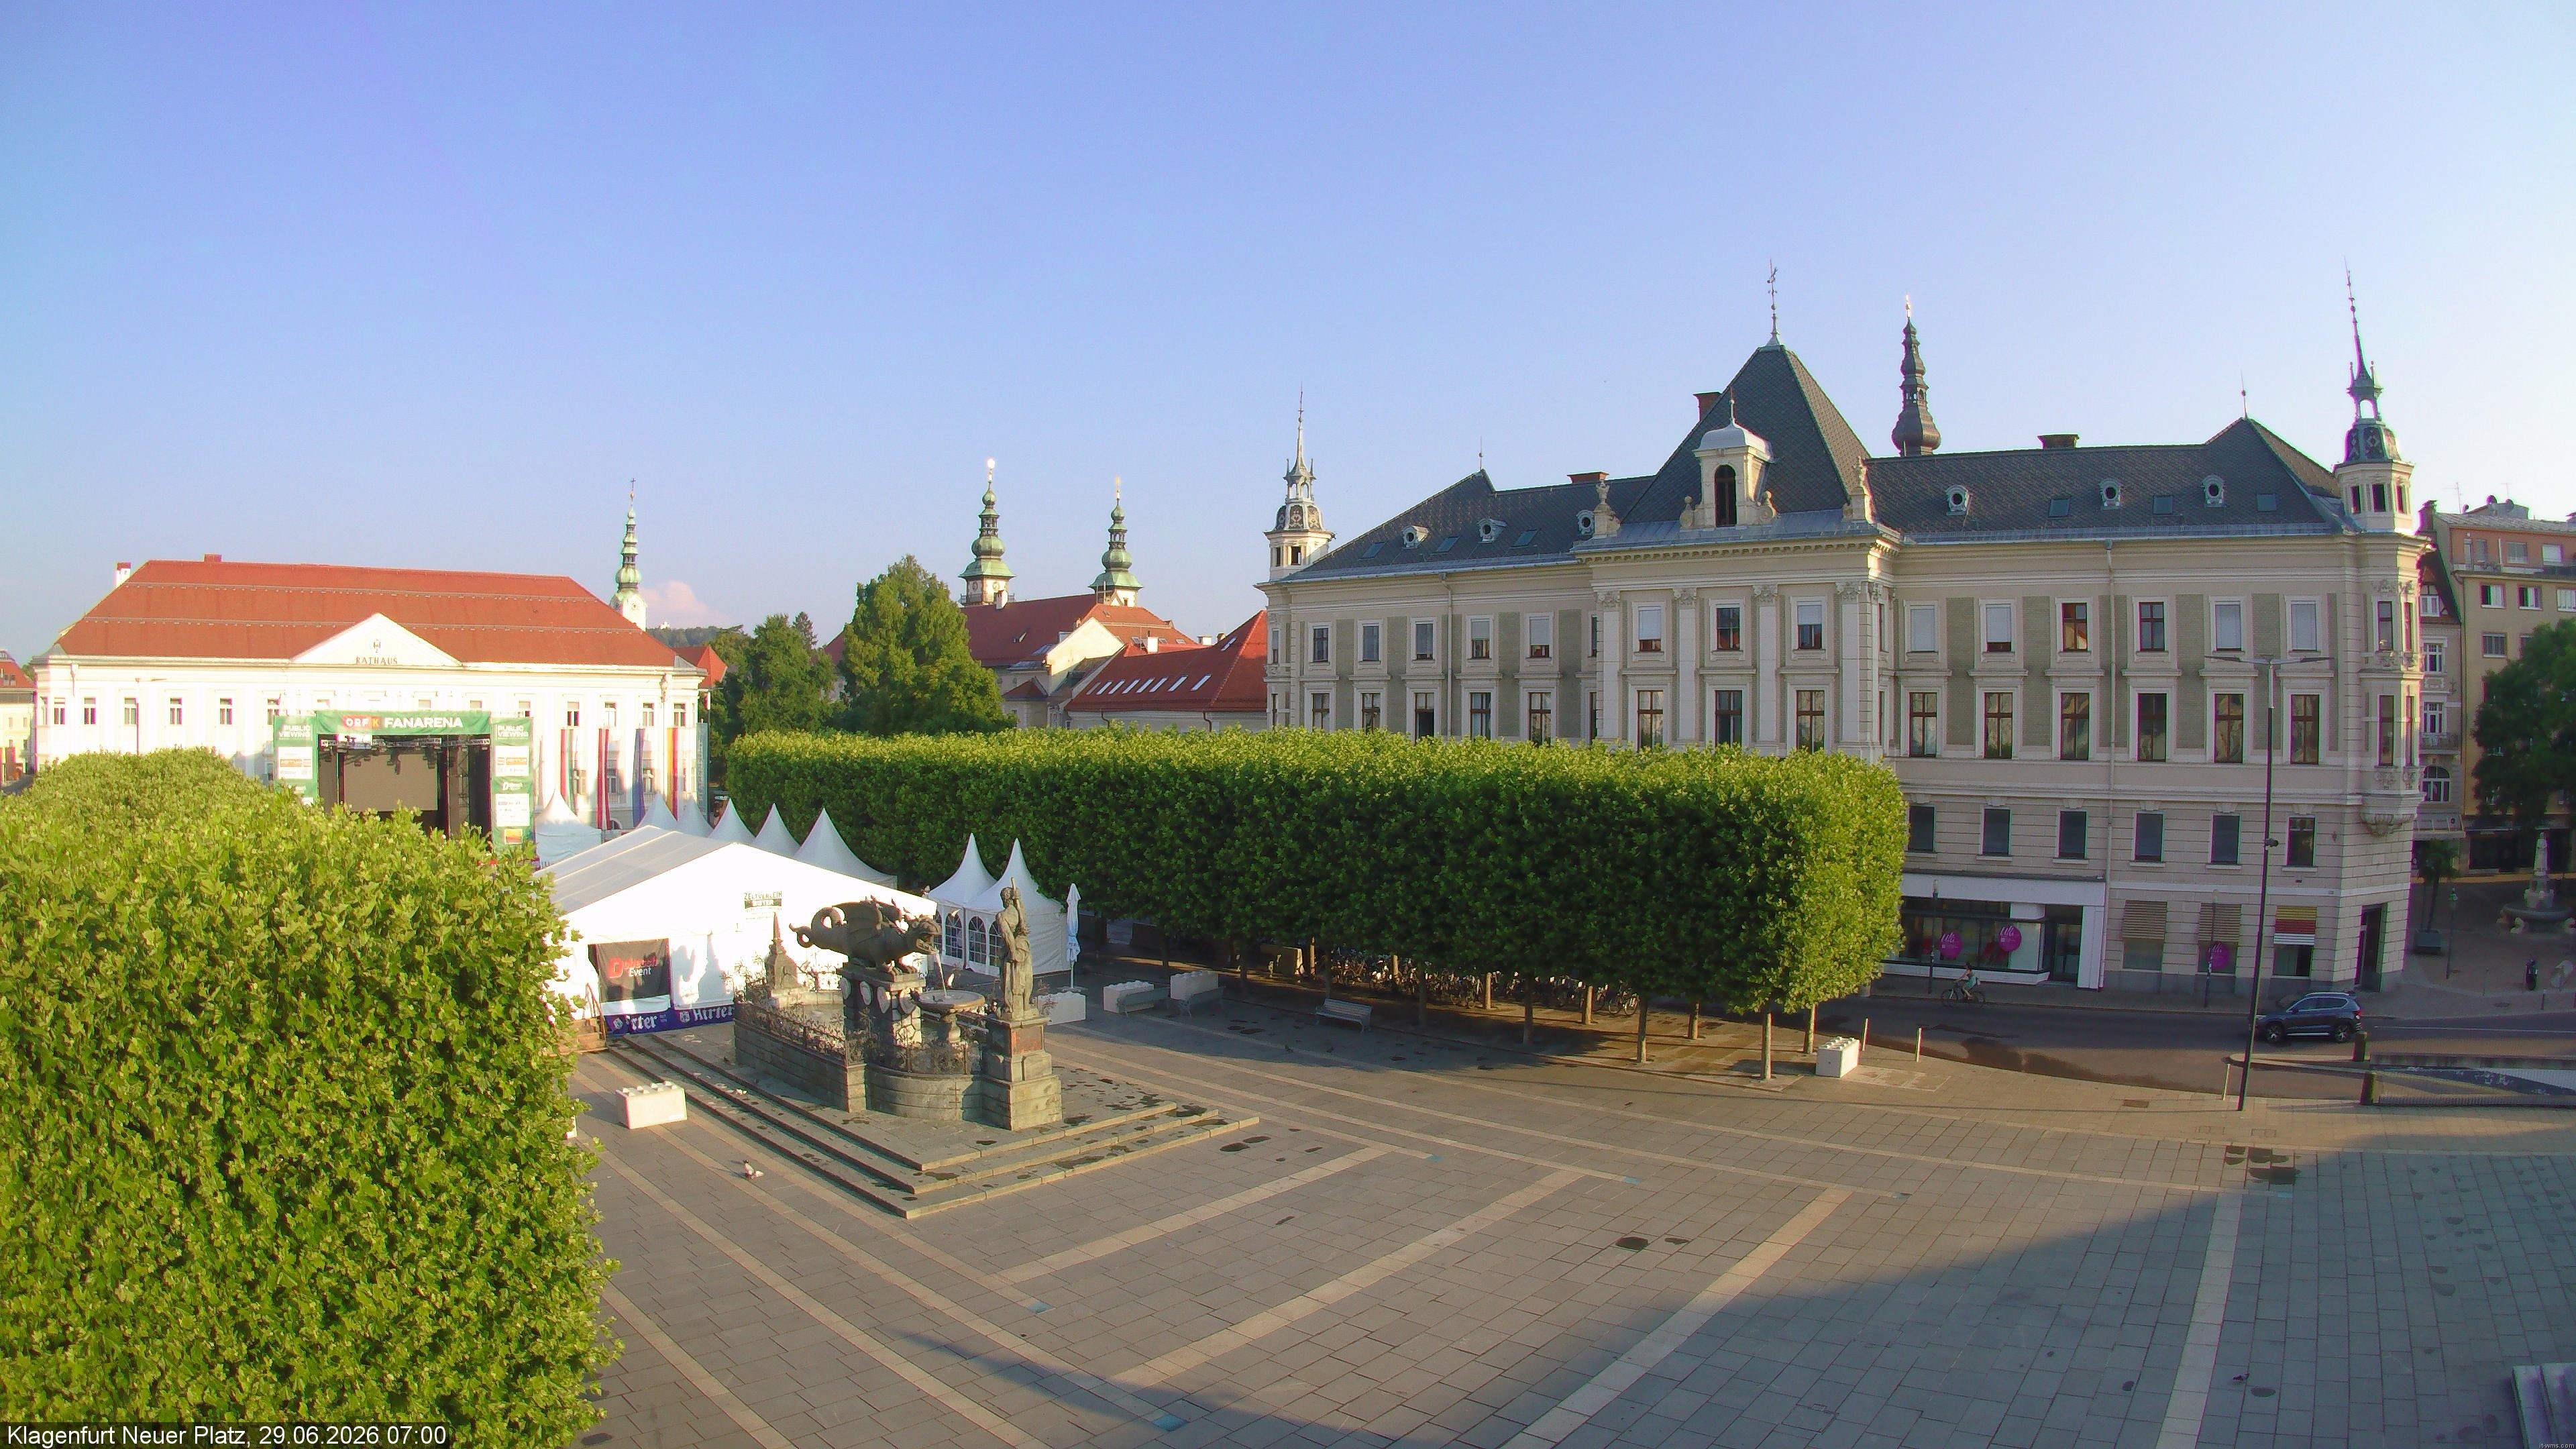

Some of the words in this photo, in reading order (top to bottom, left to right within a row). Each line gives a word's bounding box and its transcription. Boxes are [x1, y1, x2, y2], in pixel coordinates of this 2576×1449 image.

[356, 656, 398, 665] RATHAUS
[345, 717, 370, 727] ORF
[384, 716, 464, 728] FANARENA
[629, 966, 651, 977] Event
[693, 1006, 735, 1021] Hirter
[625, 1015, 657, 1030] rter
